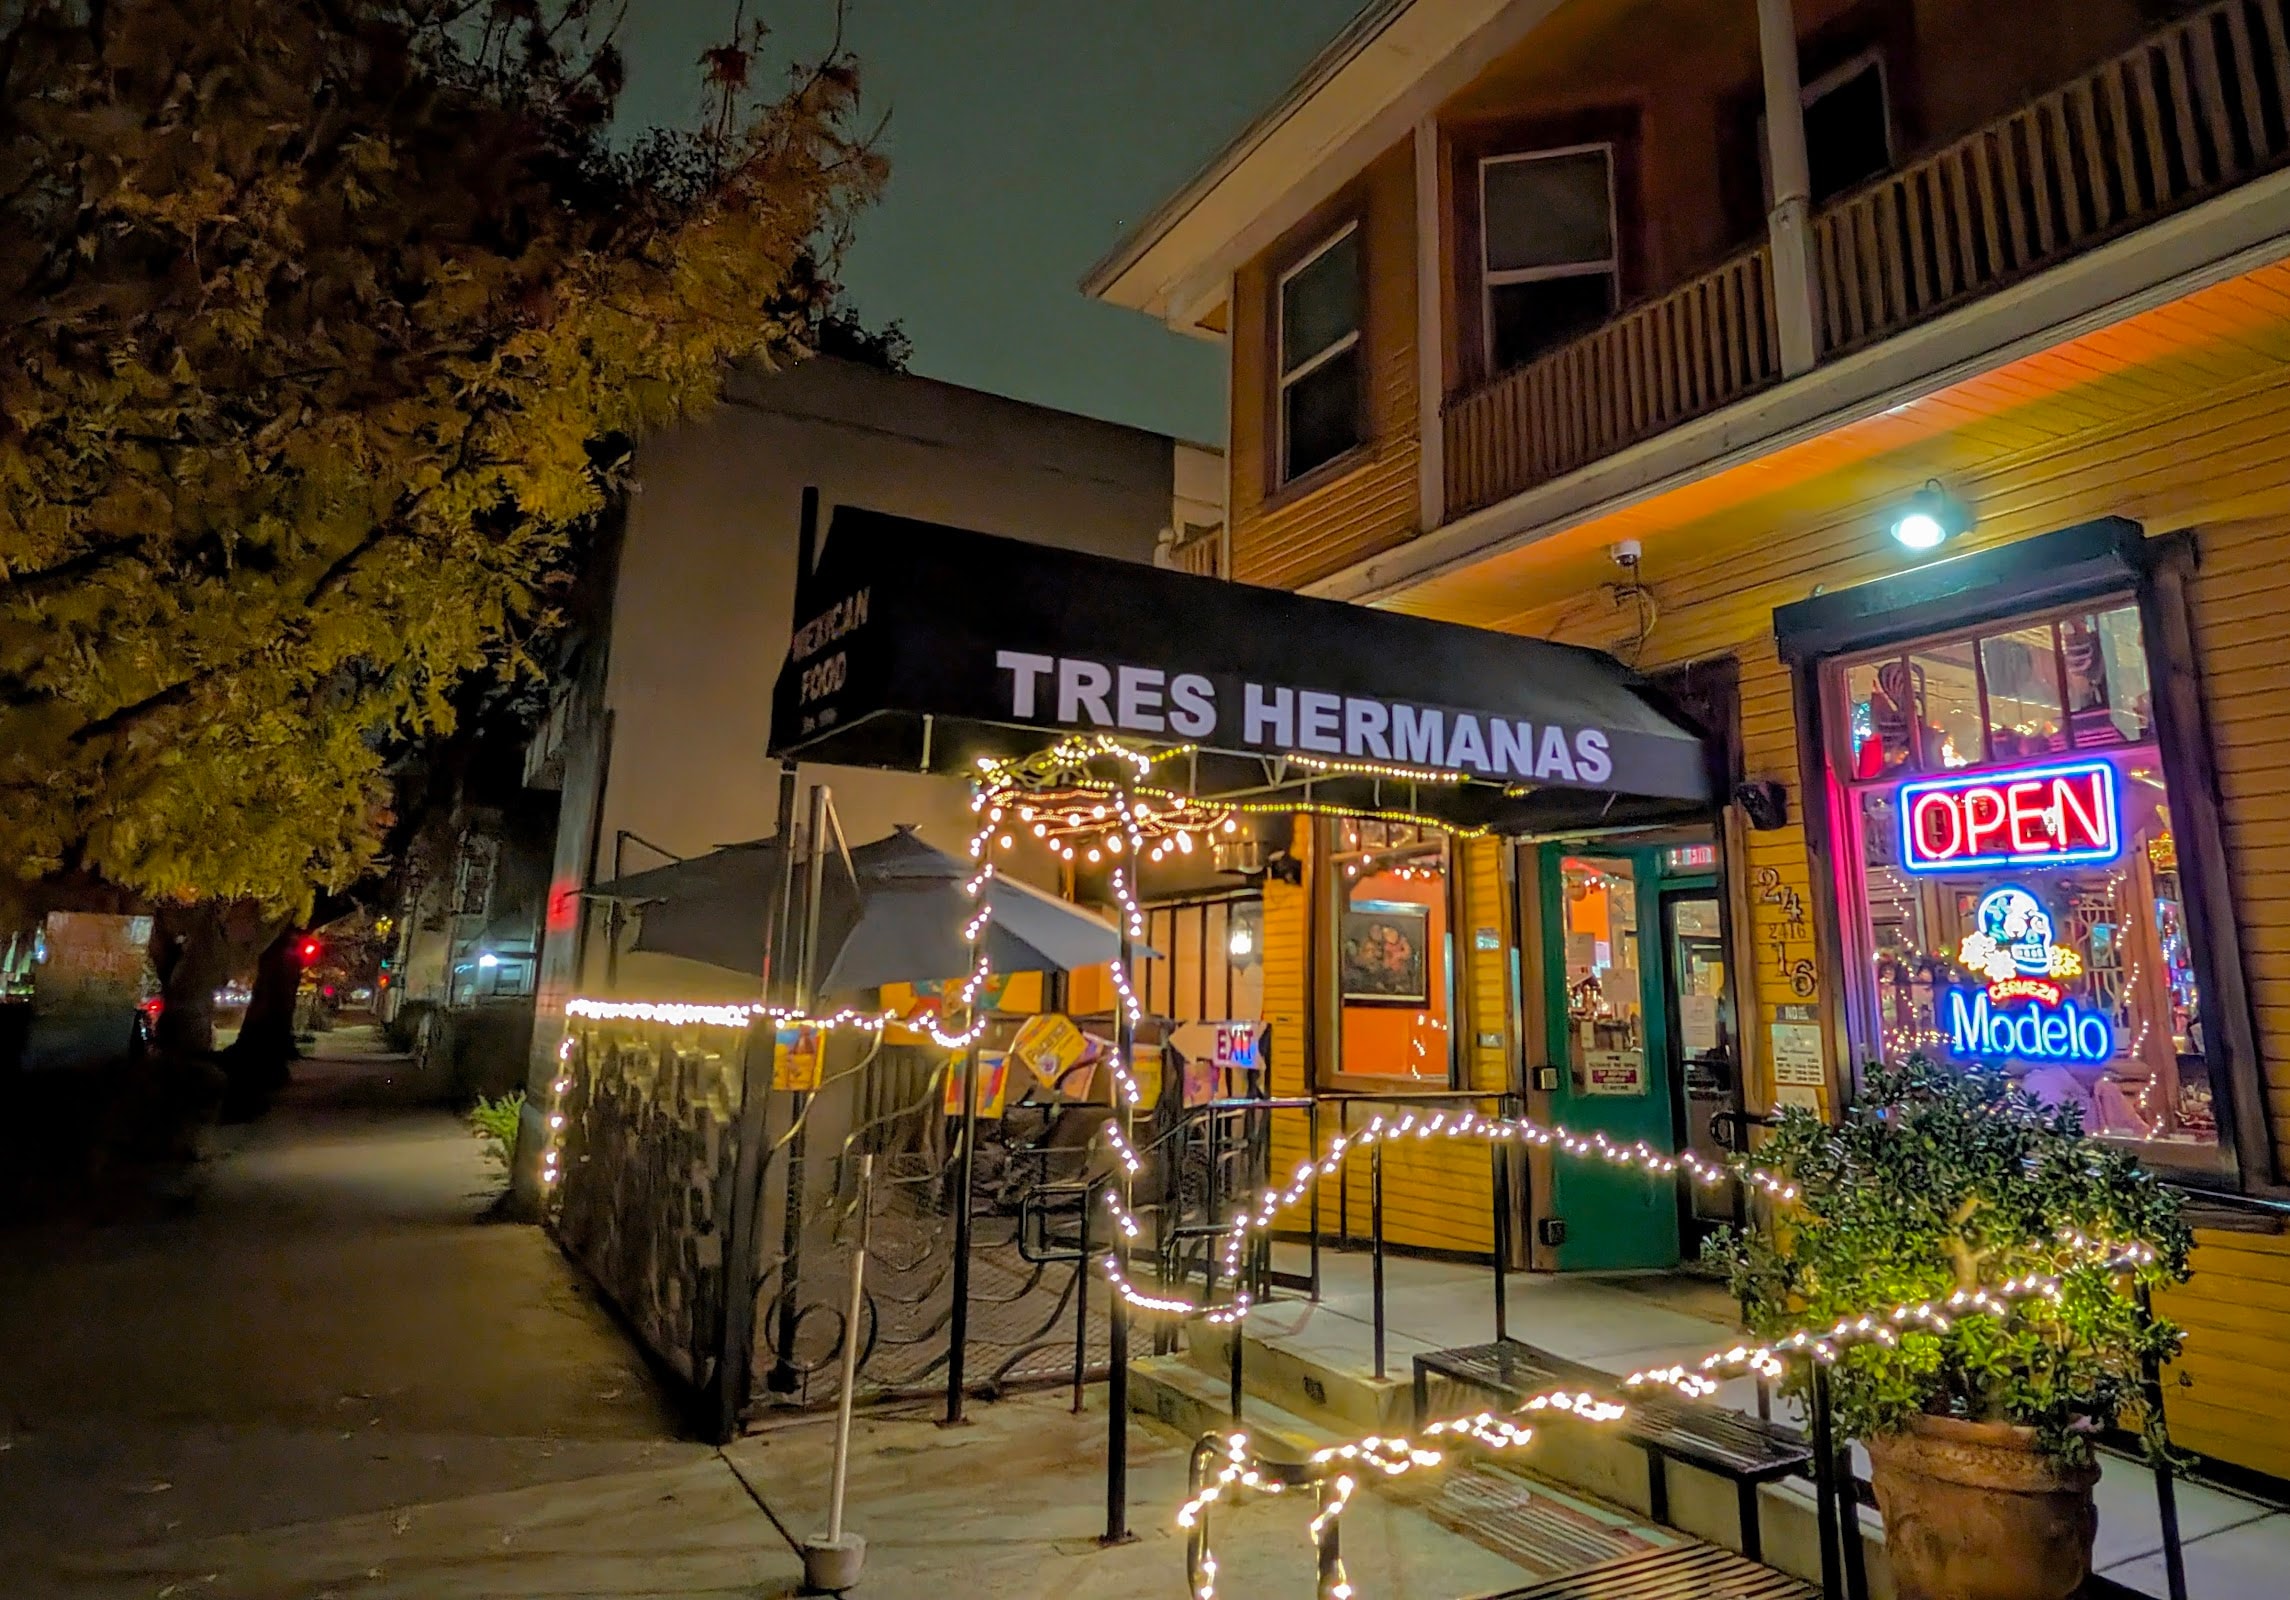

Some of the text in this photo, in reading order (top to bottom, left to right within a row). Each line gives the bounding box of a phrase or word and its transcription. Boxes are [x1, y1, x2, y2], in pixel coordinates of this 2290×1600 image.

[800, 651, 847, 706] FOOD
[996, 650, 1613, 783] TRES HERMANAS
[1914, 772, 2108, 859] OPEN
[1988, 979, 2060, 1005] CERVEZA
[1217, 1029, 1253, 1060] EXIT
[1950, 991, 2109, 1060] Modelo
